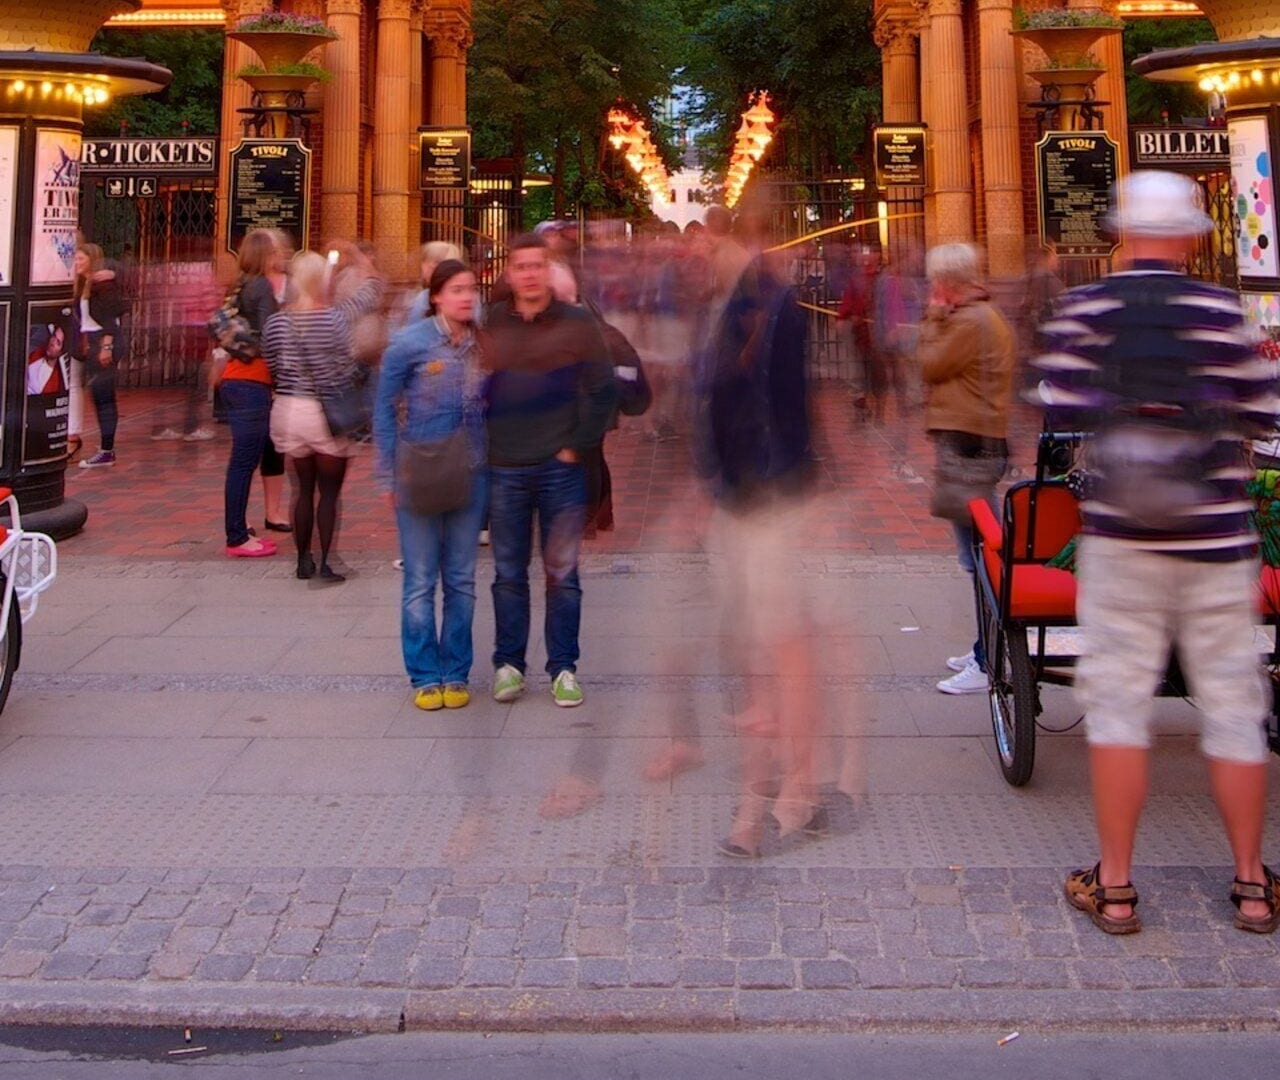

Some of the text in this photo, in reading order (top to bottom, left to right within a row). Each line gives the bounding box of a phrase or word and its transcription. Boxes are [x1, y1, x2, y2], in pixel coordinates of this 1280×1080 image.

[251, 146, 288, 156] TIVOLI
[1058, 138, 1096, 149] TIVOLI
[1140, 133, 1228, 154] BILLET
[110, 142, 213, 163] TICKETS
